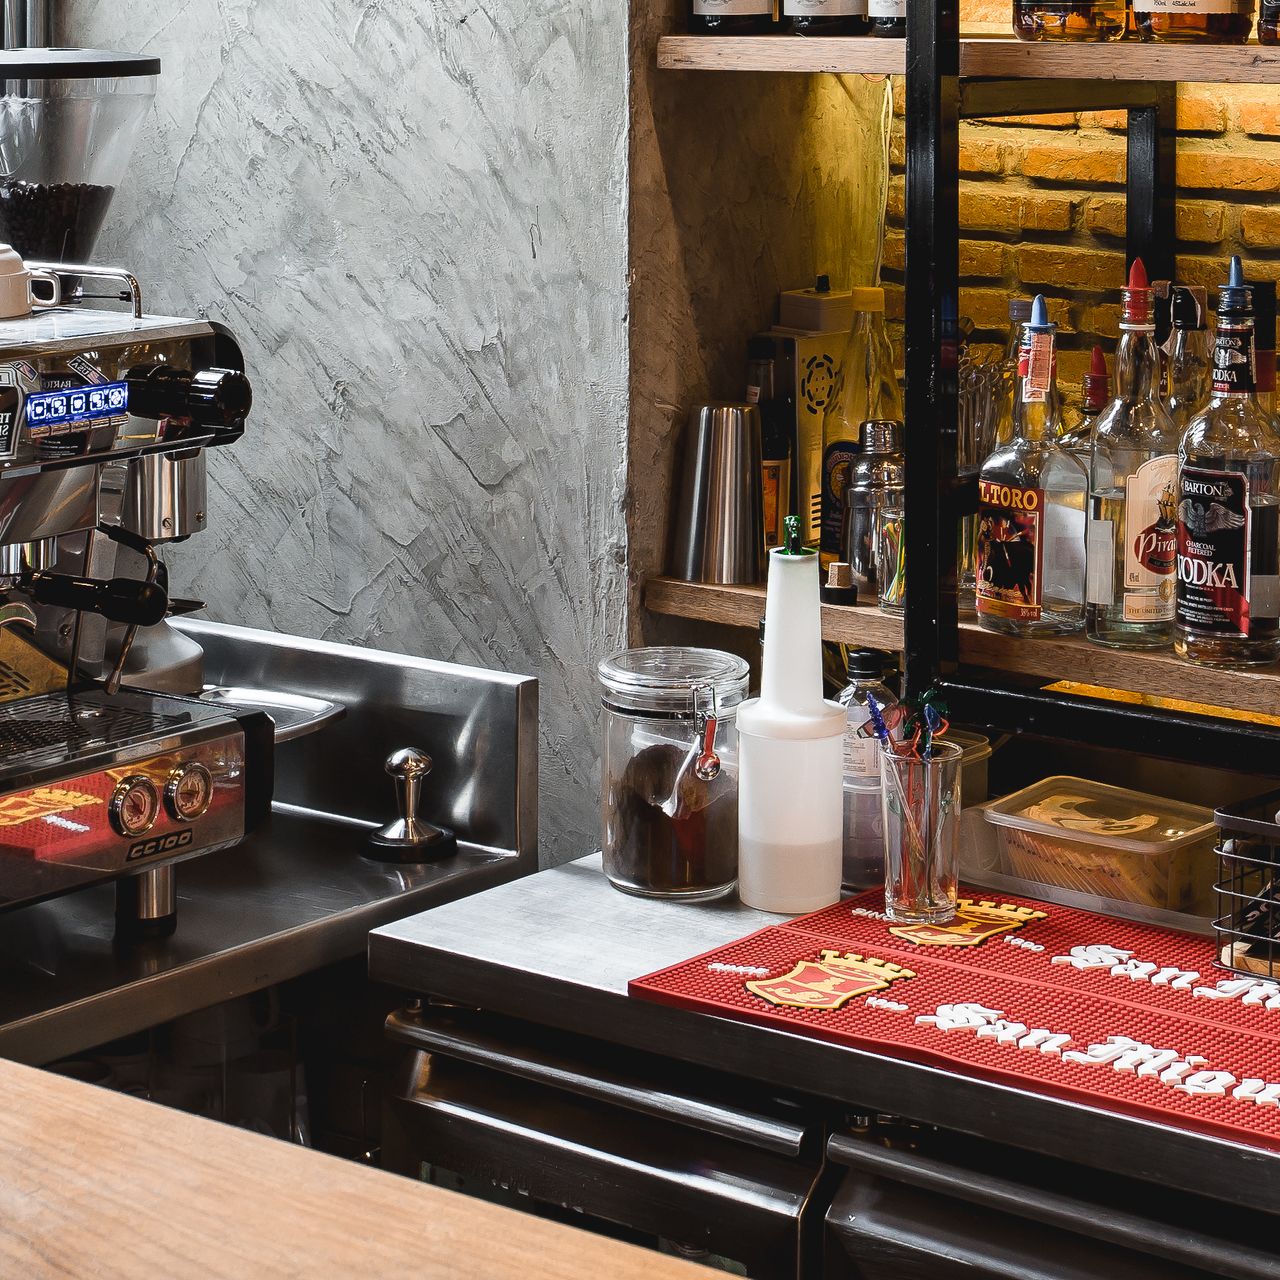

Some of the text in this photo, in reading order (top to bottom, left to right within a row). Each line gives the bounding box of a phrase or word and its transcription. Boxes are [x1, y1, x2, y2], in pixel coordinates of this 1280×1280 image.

[990, 487, 1038, 511] TORO
[1184, 479, 1224, 497] BARTON
[131, 832, 191, 859] CC100
[1051, 943, 1204, 994] San
[914, 1001, 1072, 1059] San
